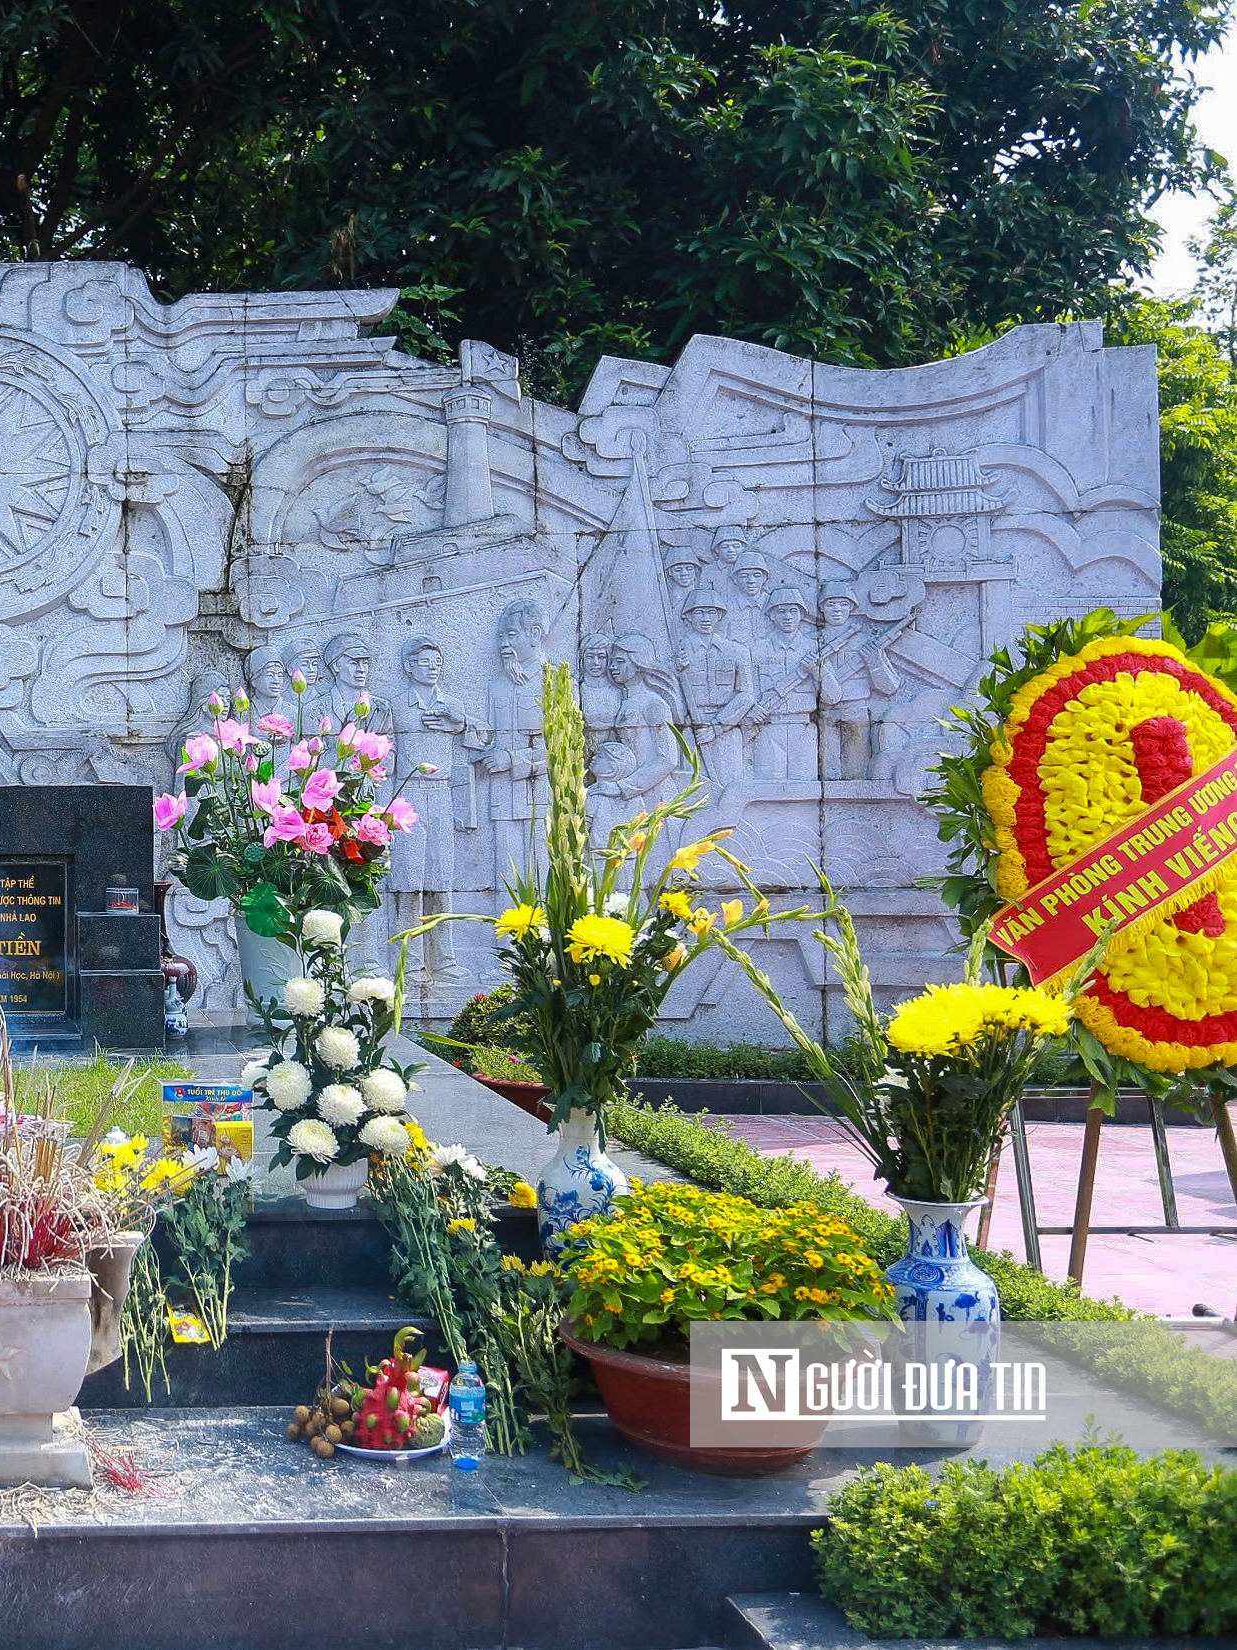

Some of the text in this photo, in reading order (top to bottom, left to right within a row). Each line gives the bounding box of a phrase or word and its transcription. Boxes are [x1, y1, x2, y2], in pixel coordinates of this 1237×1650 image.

[996, 907, 1045, 947] VĂN
[1039, 854, 1123, 916] PHÒNG
[1117, 805, 1193, 862] TRUNG
[0, 877, 17, 890] TẬP
[18, 875, 35, 889] THỂ
[17, 893, 46, 905] THÔNG
[48, 896, 61, 905] TIN
[1081, 870, 1170, 938] KÍNH
[0, 910, 18, 922] NHÀ
[19, 913, 37, 922] LAO
[29, 970, 41, 980] Hà
[42, 971, 55, 981] Nội
[9, 994, 28, 1003] 1954
